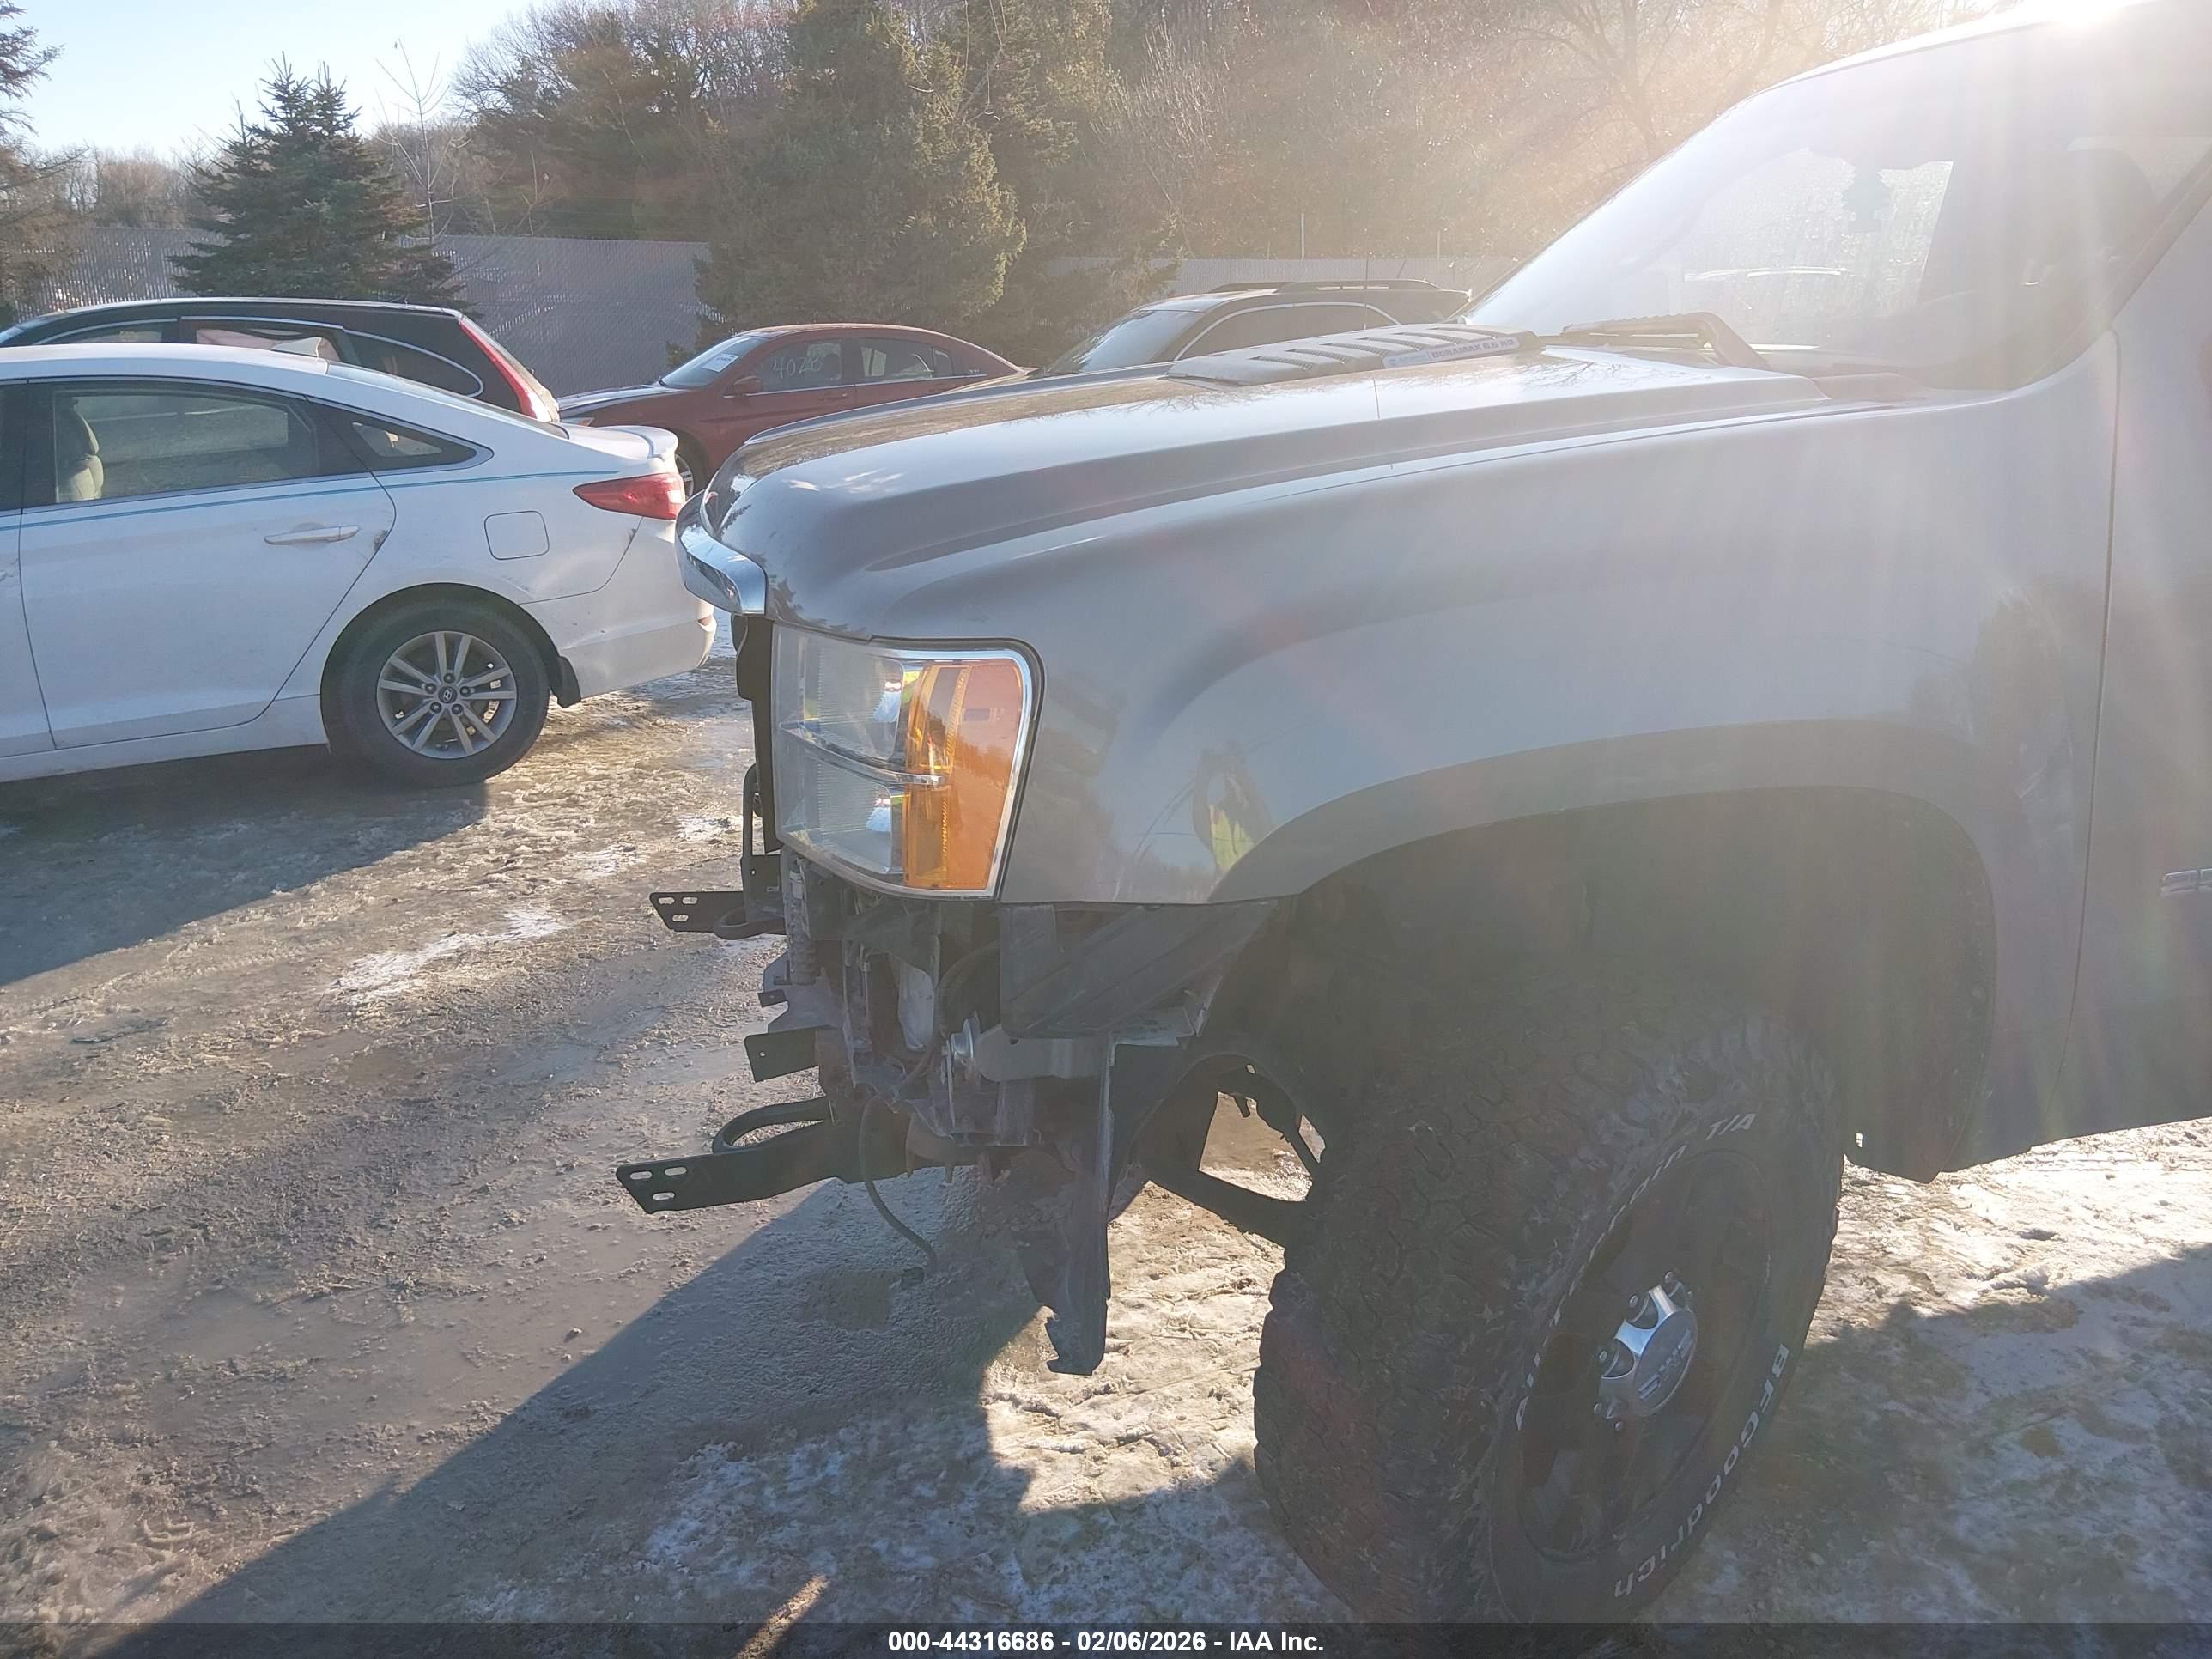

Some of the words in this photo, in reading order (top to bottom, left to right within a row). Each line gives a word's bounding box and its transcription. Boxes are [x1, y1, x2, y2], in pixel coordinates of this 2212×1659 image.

[1431, 343, 1482, 359] DURAMAX
[1705, 1113, 1758, 1142] T/A
[1613, 1344, 1790, 1598] BFGoodrich
